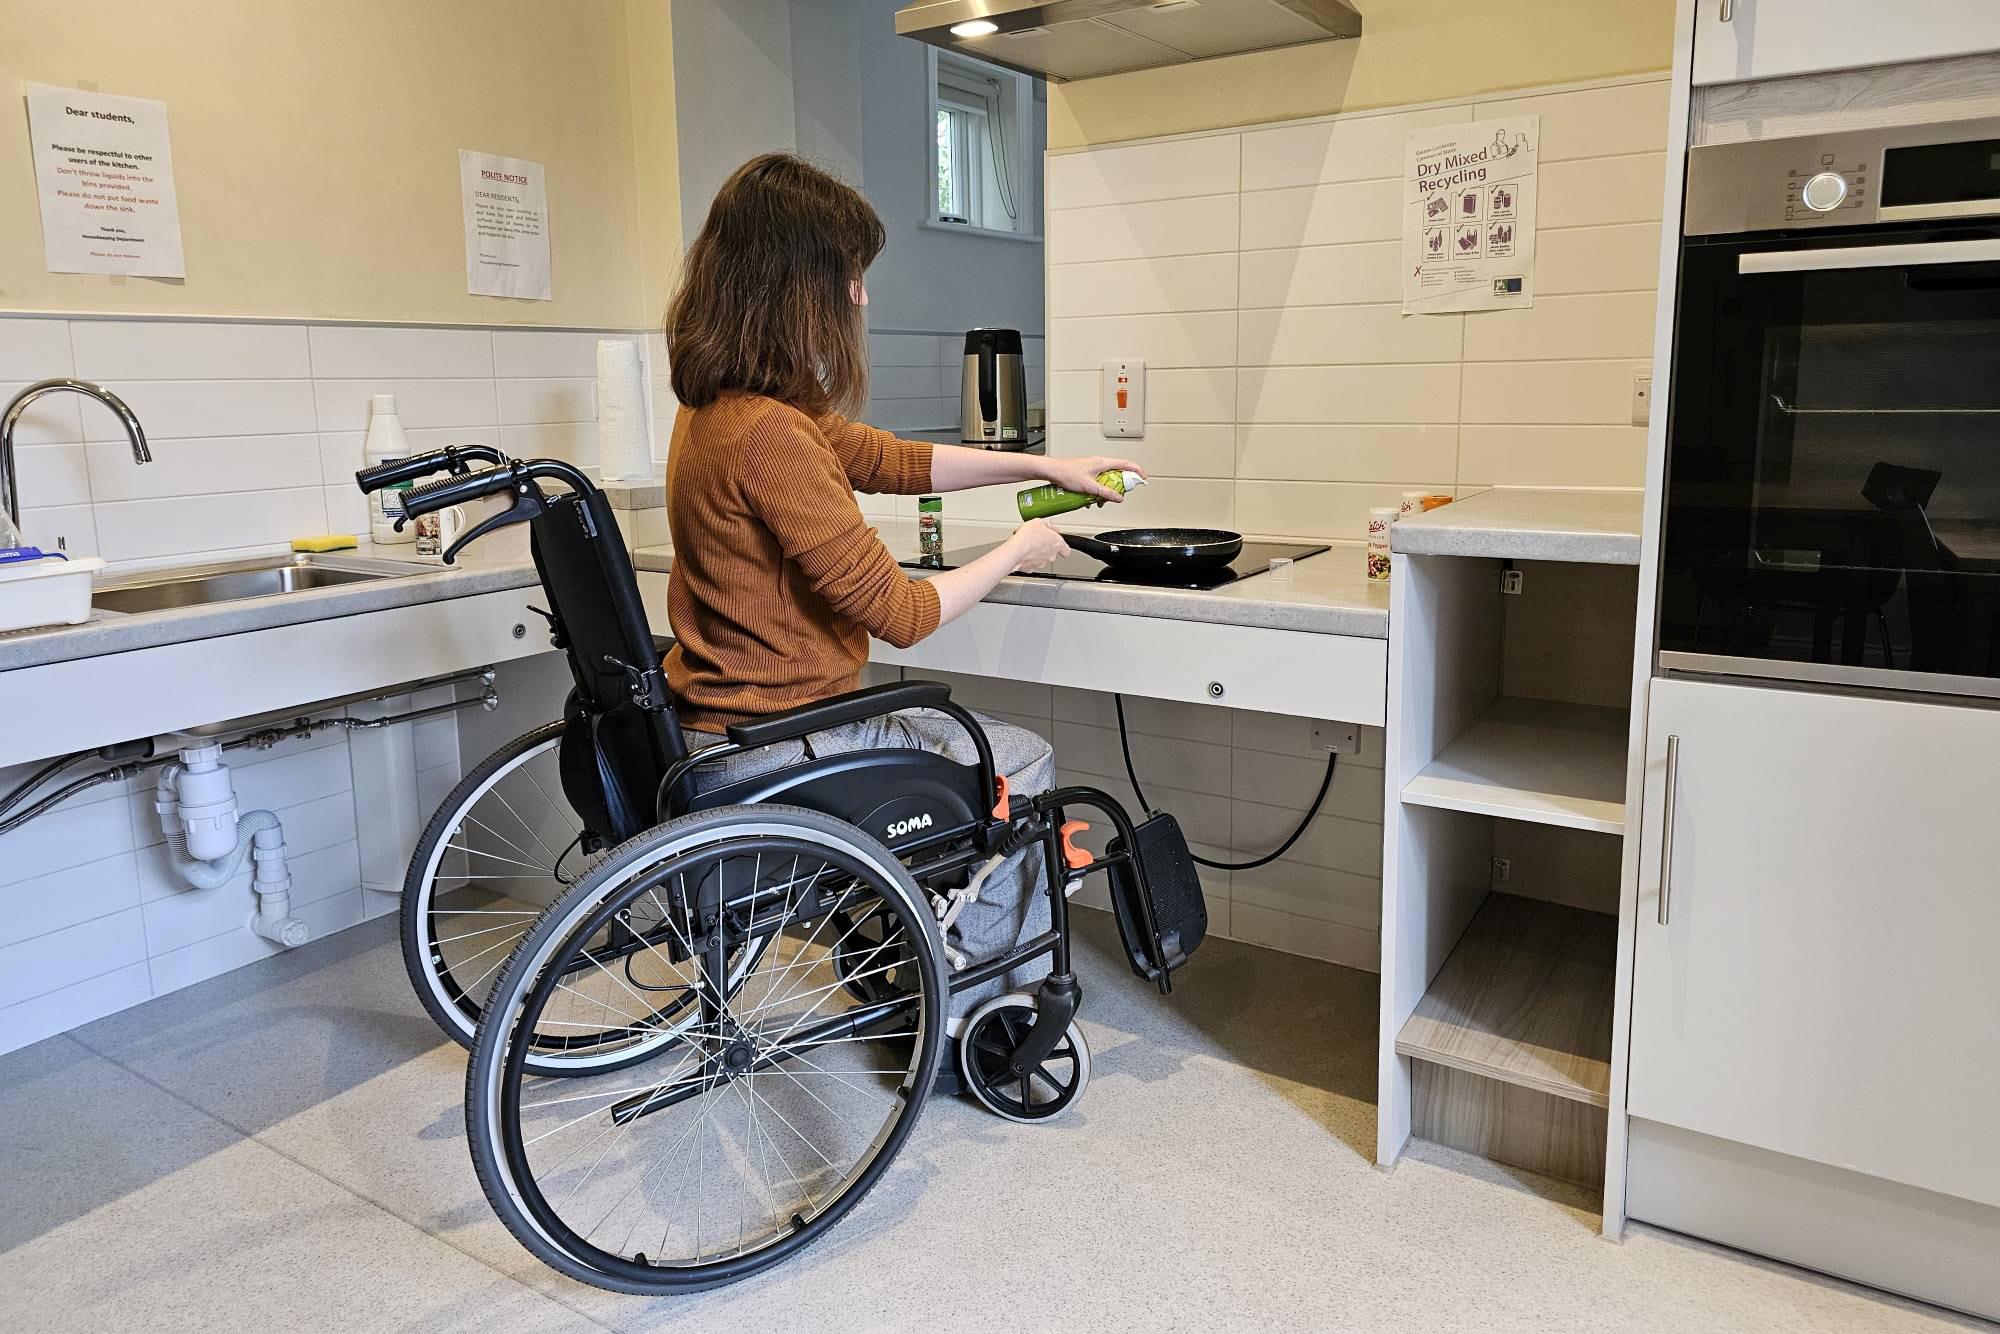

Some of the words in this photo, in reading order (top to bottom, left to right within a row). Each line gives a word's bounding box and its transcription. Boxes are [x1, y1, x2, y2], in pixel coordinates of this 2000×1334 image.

[65, 106, 89, 117] Dear
[90, 110, 135, 125] students,
[51, 143, 75, 153] Please
[87, 149, 123, 158] respectful
[112, 161, 140, 170] kitchen.
[1417, 162, 1441, 176] Dry
[1445, 146, 1488, 170] Mixed
[56, 167, 77, 175] Don't
[101, 172, 125, 180] liquids
[126, 174, 141, 182] into
[481, 170, 503, 180] POLITE
[503, 174, 528, 184] NOTICE
[1419, 167, 1487, 193] Recycling
[81, 180, 97, 188] bins
[57, 190, 80, 198] Please
[886, 813, 933, 839] SOMA
